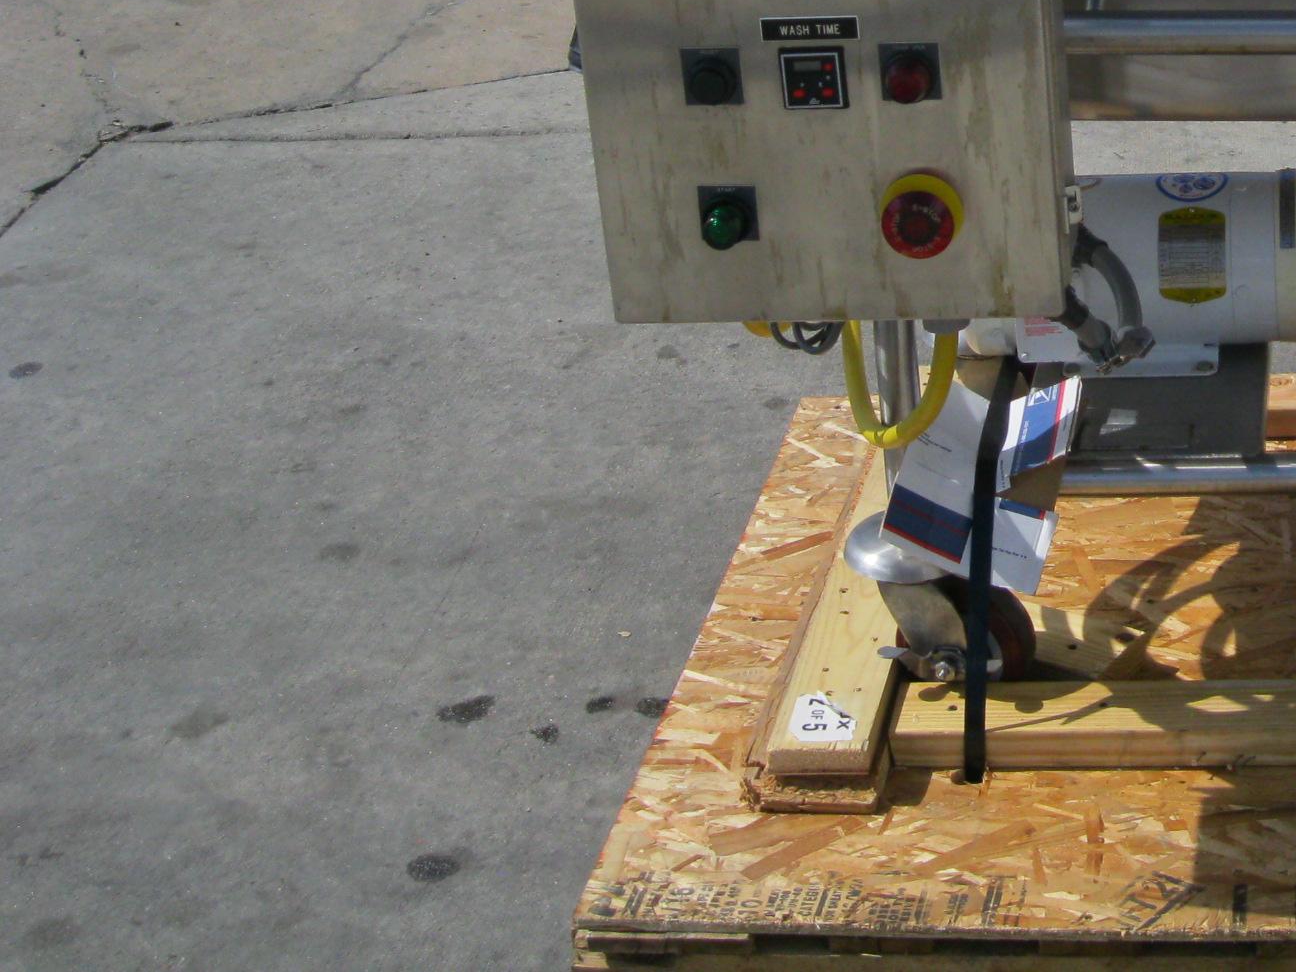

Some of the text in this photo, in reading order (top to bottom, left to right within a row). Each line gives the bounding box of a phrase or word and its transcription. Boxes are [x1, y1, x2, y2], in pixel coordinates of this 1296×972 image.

[779, 23, 842, 36] WASH TIME
[801, 723, 828, 731] 5
